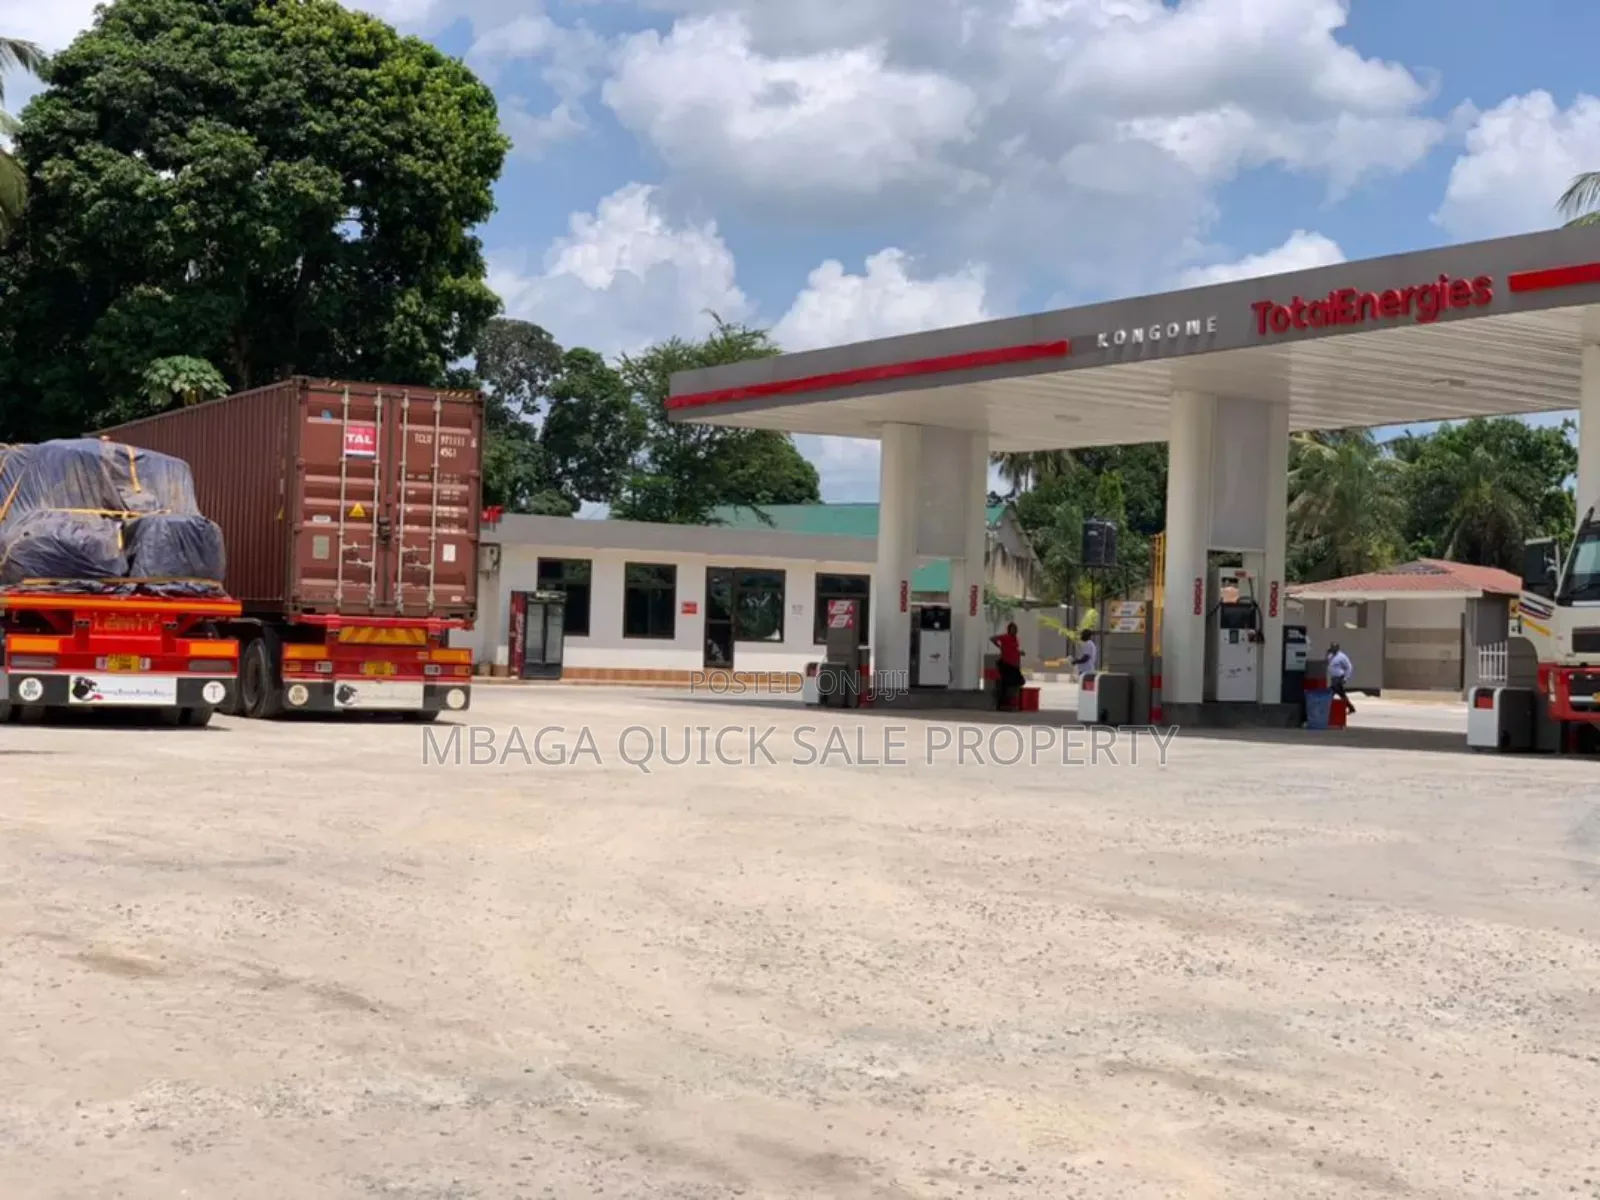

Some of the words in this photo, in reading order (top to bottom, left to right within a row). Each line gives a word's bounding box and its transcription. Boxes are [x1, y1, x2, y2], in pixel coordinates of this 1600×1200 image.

[1250, 273, 1494, 335] TotalEnergies
[347, 433, 374, 445] TAL
[208, 684, 219, 700] T
